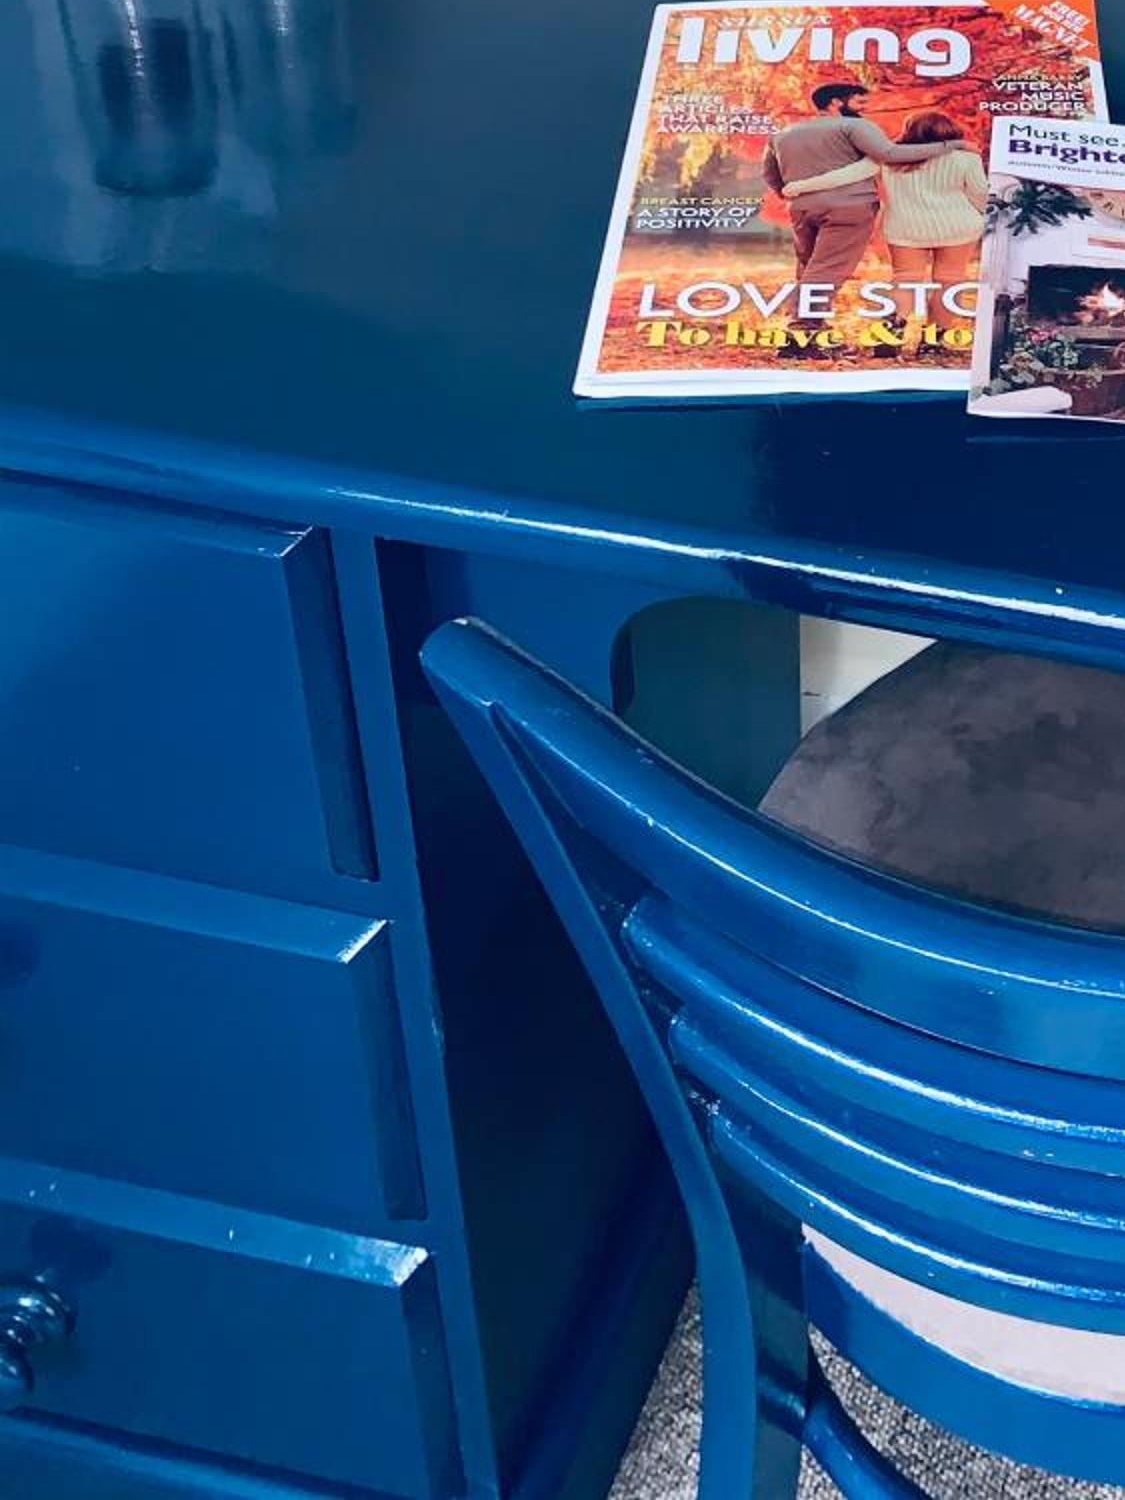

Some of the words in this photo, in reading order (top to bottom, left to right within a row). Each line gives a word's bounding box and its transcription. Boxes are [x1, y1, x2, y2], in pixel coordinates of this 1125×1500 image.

[677, 17, 972, 78] living
[993, 81, 1083, 91] VETERAN
[1021, 91, 1085, 101] MUSIC
[980, 101, 1085, 111] PRODUCER
[660, 113, 710, 124] THAT
[715, 114, 773, 125] RAISE
[656, 123, 781, 134] AWARENESS
[1009, 123, 1071, 142] Must
[641, 197, 697, 206] BREAST
[700, 197, 764, 206] CANCER
[638, 207, 652, 217] A
[657, 207, 726, 218] STORY
[728, 207, 757, 218] OF
[636, 218, 746, 229] POSITIVITY
[639, 281, 835, 320] LOVE
[638, 320, 710, 347] To
[725, 320, 845, 348] have
[859, 319, 903, 348] &
[922, 321, 974, 348] to
